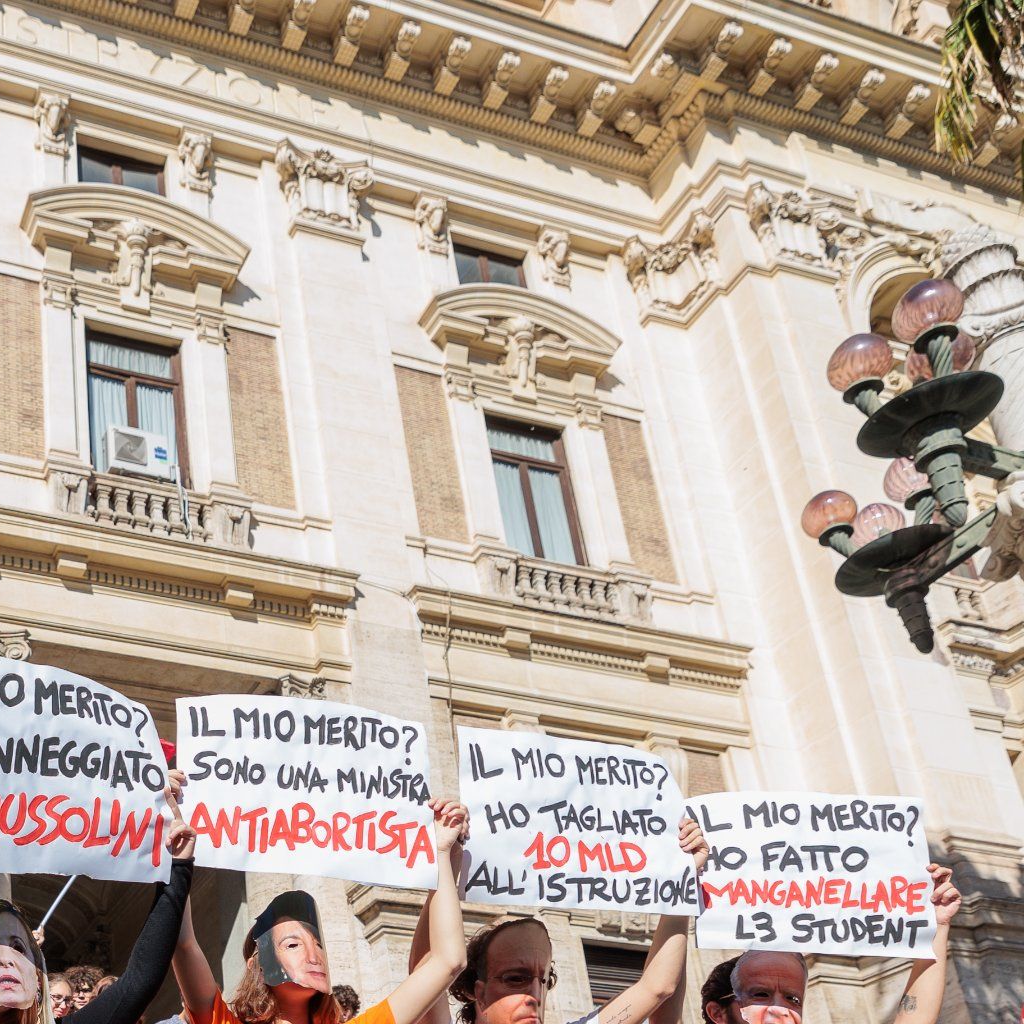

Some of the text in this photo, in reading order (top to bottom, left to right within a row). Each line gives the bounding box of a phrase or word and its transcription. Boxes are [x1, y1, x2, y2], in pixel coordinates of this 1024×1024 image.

[34, 678, 148, 748] MERITO?
[189, 706, 418, 765] IL MIO MERITO?
[189, 751, 431, 806] SONO UNA MINISTRA
[469, 743, 668, 801] IL MIO MERITO?
[189, 802, 435, 868] ANTIABORTISTA
[485, 800, 666, 836] HO TAGLIATO
[743, 801, 800, 829] MIO
[811, 800, 919, 847] MERITO?
[524, 831, 647, 873] 10 MLD
[761, 841, 868, 873] FATTO
[701, 876, 927, 915] MANGANELLARE
